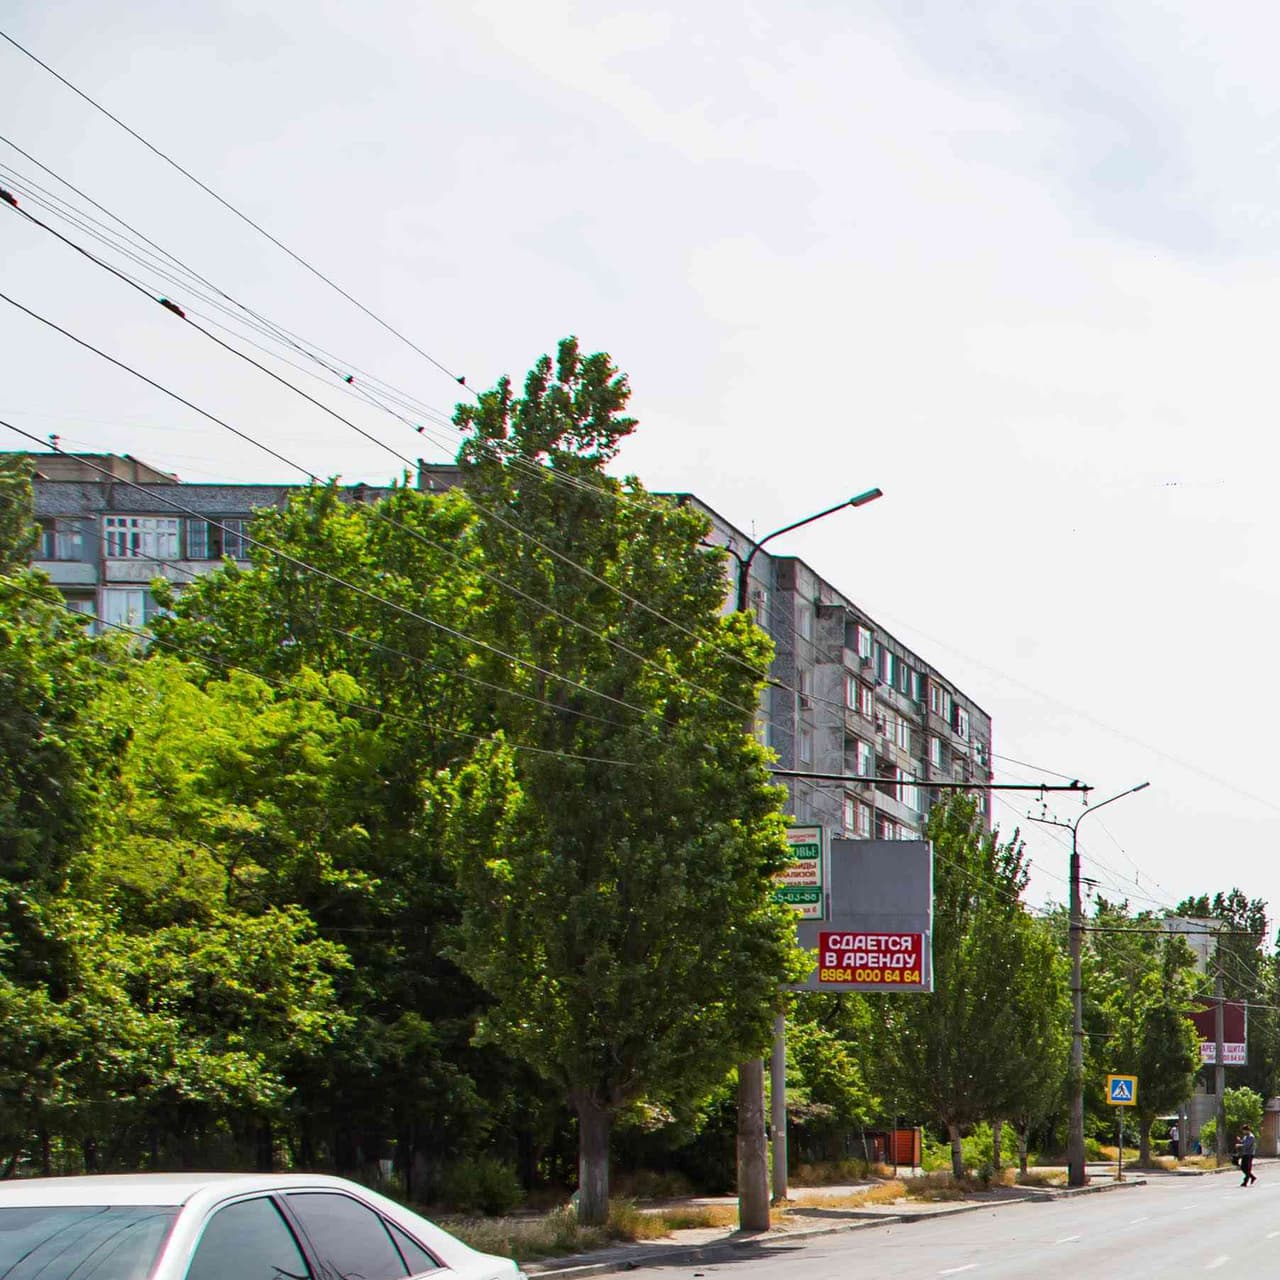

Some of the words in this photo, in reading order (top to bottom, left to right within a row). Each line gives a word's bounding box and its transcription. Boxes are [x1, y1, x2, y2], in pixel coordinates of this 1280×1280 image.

[828, 935, 912, 950] СДАЕТСЯ
[825, 952, 837, 966] В
[842, 952, 916, 968] АРЕНДУ
[821, 968, 852, 981] 8964
[855, 969, 881, 982] 000
[884, 970, 900, 982] 64
[904, 970, 920, 983] 64
